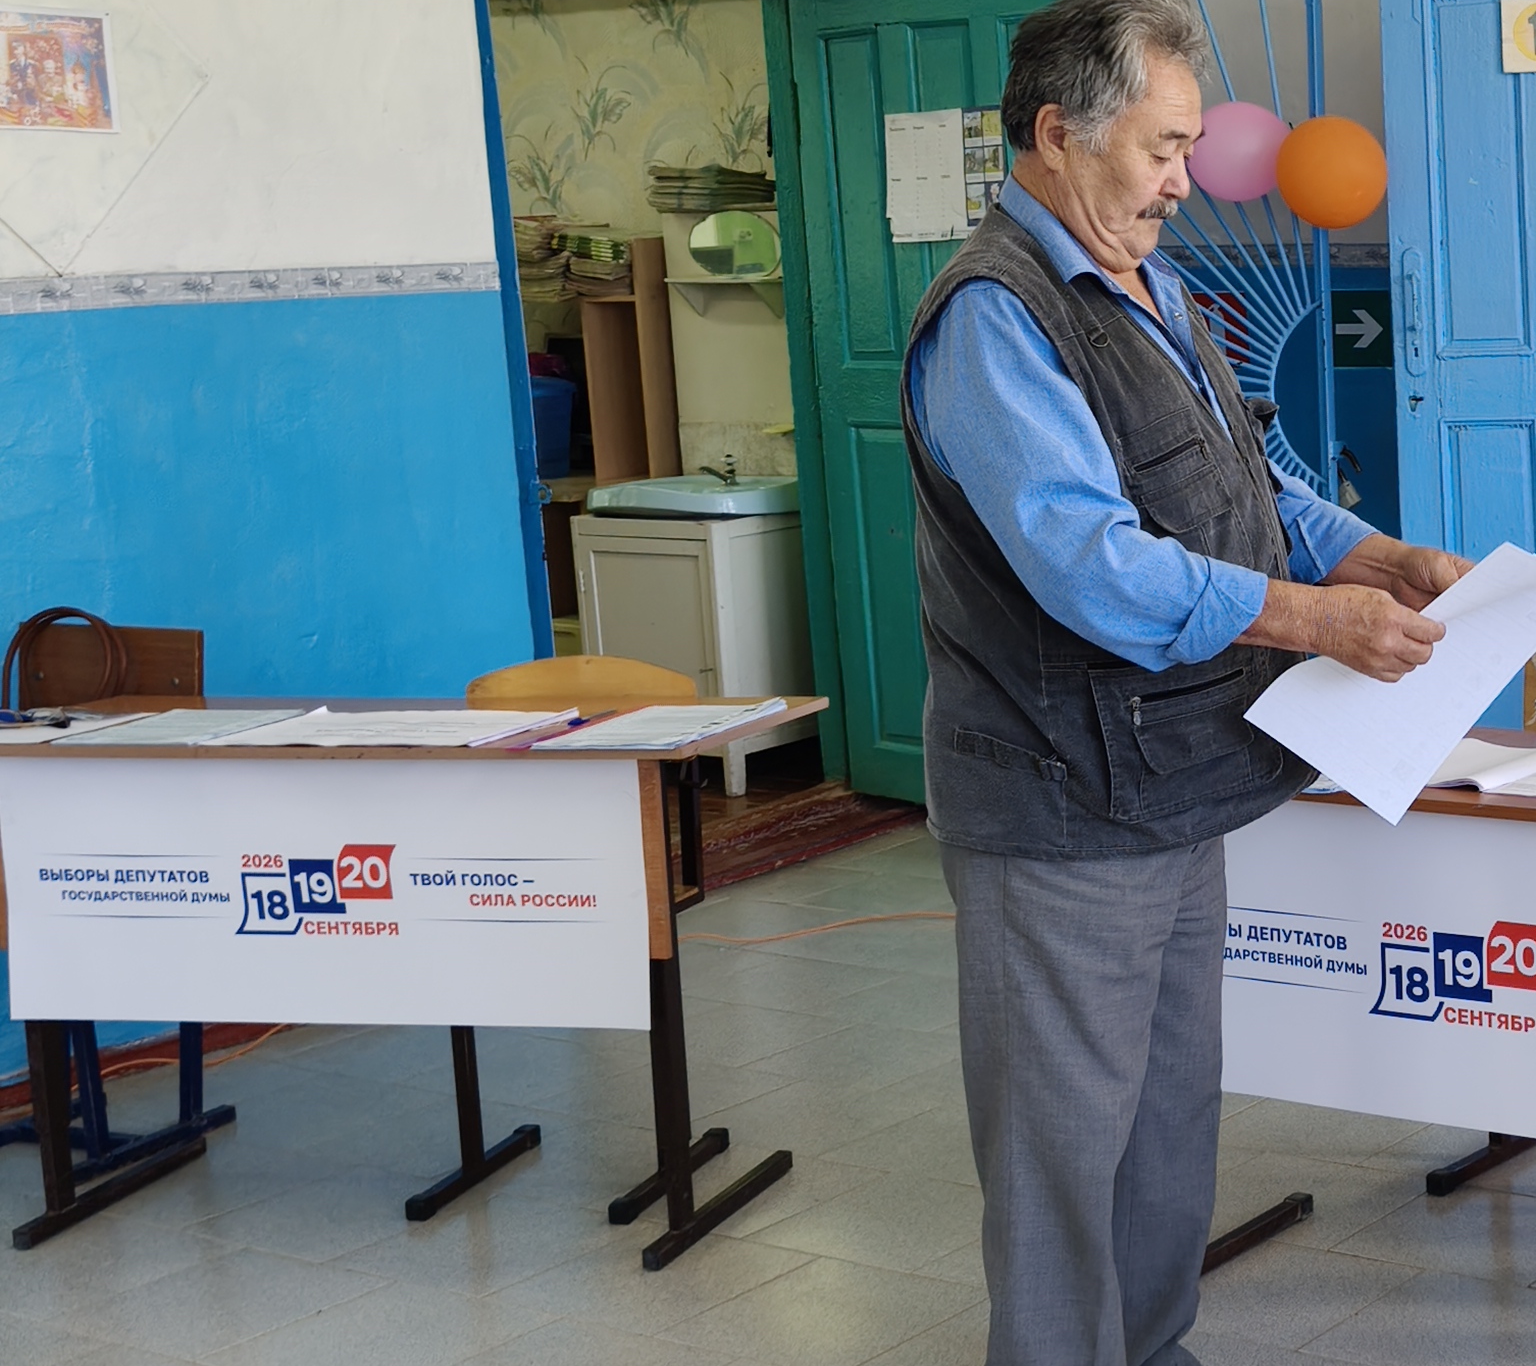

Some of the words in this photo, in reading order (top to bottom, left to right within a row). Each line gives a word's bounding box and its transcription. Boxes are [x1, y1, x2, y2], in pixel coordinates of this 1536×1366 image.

[241, 854, 284, 868] 2026
[39, 868, 110, 882] ВЫБОРЫ
[114, 869, 210, 884] ДЕПУТАТОВ
[409, 870, 456, 886] ТВОЙ
[461, 873, 519, 886] ГОЛОС
[250, 889, 290, 920] 18
[294, 871, 334, 904] 19
[339, 855, 388, 889] 20
[61, 889, 188, 903] ГОСУДАРСТВЕННОЙ
[191, 891, 231, 904] ДУМЫ
[469, 893, 517, 907] СИЛА
[521, 894, 597, 908] РОССИИ!
[303, 920, 400, 936] СЕНТЯБРЯ
[1382, 921, 1428, 942] 2026
[1246, 925, 1348, 951] ДЕПУТАТОВ
[1223, 946, 1323, 970] ДАРСТВЕННОЙ
[1325, 959, 1368, 976] ДУМЫ
[1389, 965, 1430, 1003] 18
[1437, 948, 1481, 988] 19
